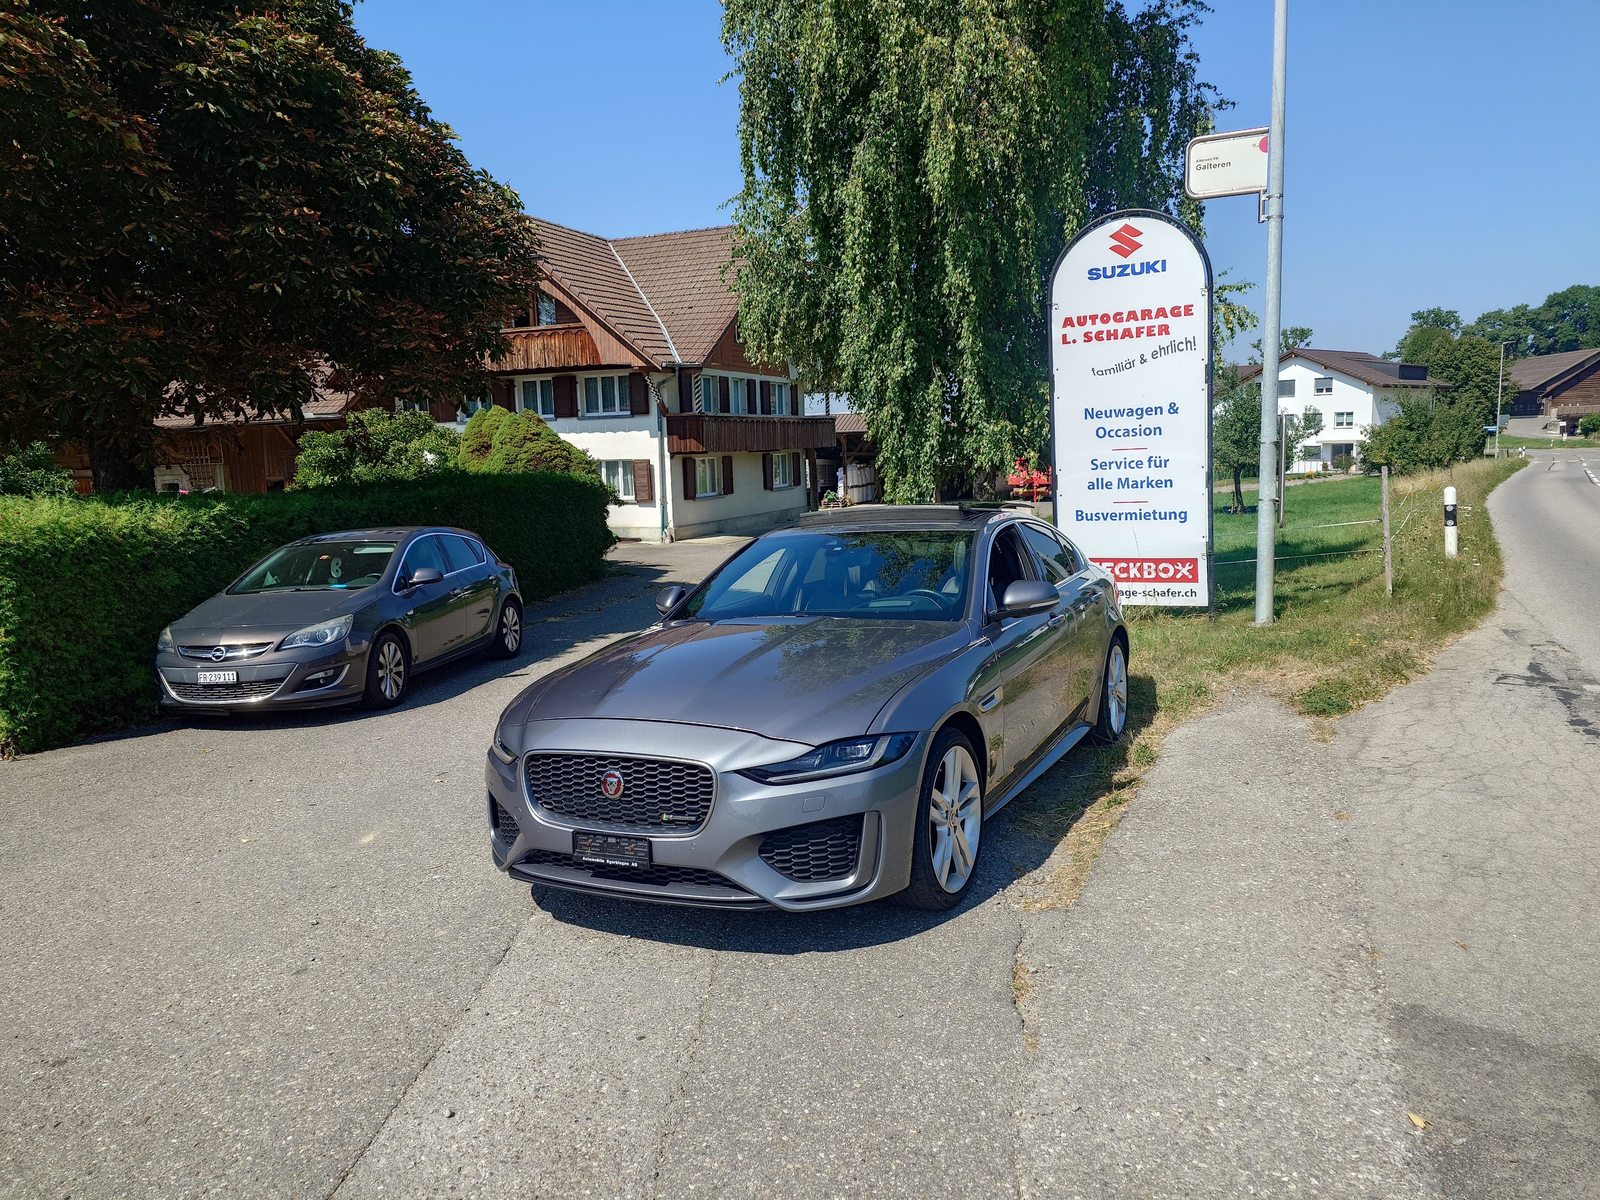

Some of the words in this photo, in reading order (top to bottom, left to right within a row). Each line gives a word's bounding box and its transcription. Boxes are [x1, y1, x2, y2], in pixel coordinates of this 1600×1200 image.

[1195, 161, 1231, 171] Galteren
[1087, 259, 1167, 281] SUZUKI
[1061, 304, 1194, 329] AUTOGARAGE
[1061, 333, 1077, 345] L.
[1083, 323, 1170, 343] SCHAFER
[1091, 358, 1136, 377] familiär
[1139, 353, 1148, 365] &
[1151, 336, 1197, 360] ehrlich!
[1084, 405, 1164, 420] Neuwagen
[1167, 401, 1179, 415] &
[1095, 424, 1163, 439] Occasion
[1090, 457, 1144, 471] Service
[1147, 455, 1170, 469] für
[1087, 477, 1113, 491] alle
[1117, 476, 1174, 490] Marken
[1075, 508, 1188, 524] Busvermietung
[1096, 561, 1194, 579] ECKBOX
[1119, 587, 1197, 599] age-schafer.ch
